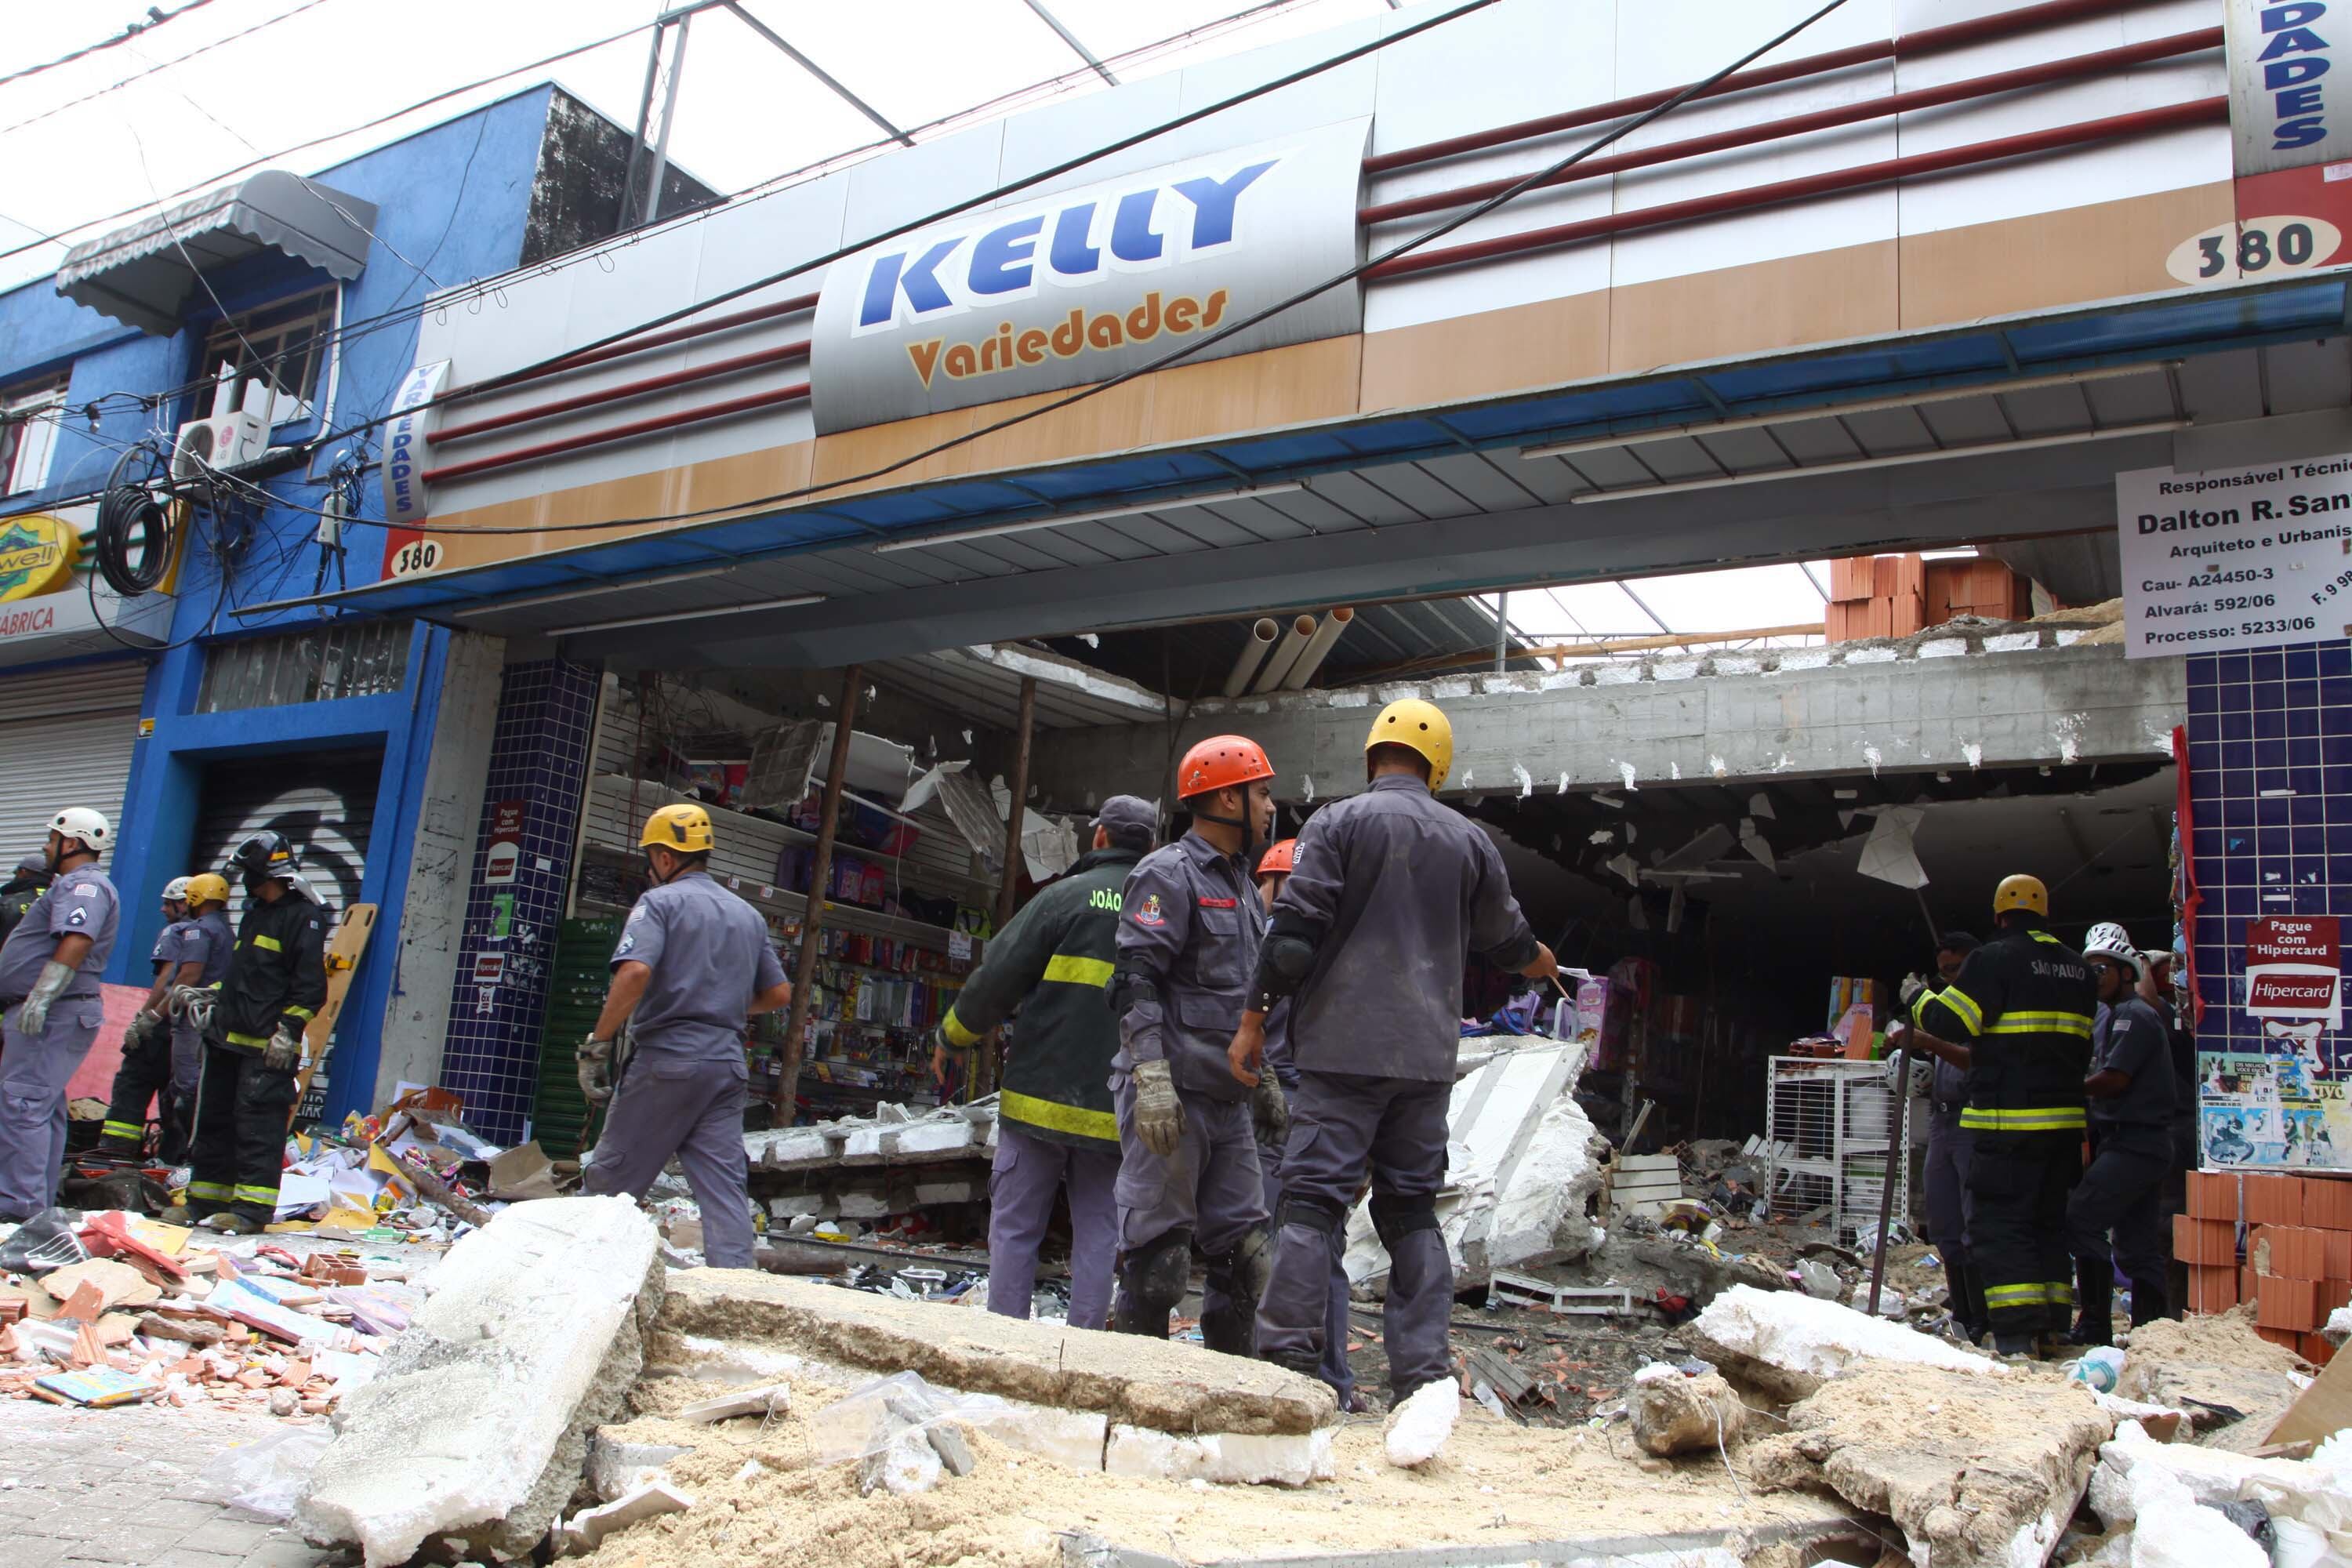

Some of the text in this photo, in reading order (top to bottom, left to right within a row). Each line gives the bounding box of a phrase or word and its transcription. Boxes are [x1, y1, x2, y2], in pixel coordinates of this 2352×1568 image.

[2256, 0, 2331, 151] DADES
[859, 158, 1282, 328] KELLY
[2198, 222, 2314, 279] 380
[908, 288, 1228, 389] Variedades
[390, 365, 439, 514] VAREDADES
[2159, 468, 2284, 495] Responsável
[2138, 492, 2352, 535] Dalton R. San
[399, 544, 436, 574] 380
[2169, 538, 2256, 559] Arquiteto
[2261, 535, 2273, 547] e
[2141, 567, 2274, 593] Cau- A24450-3
[2325, 583, 2338, 596] 9
[2144, 593, 2276, 619] Alvará: 592/06
[0, 606, 54, 635] ÁBRICA
[2144, 616, 2316, 644] Processo: 5233/06
[500, 808, 519, 818] Pague
[494, 825, 521, 835] Hipercard
[489, 863, 514, 873] Hipercard
[1089, 887, 1123, 913] JOÃO
[2270, 920, 2313, 934] Pague
[2277, 935, 2307, 944] com
[2257, 944, 2328, 958] Hipercard
[478, 960, 502, 973] Hipercard
[2052, 964, 2086, 981] PAULO
[2255, 983, 2331, 1000] Hipercard
